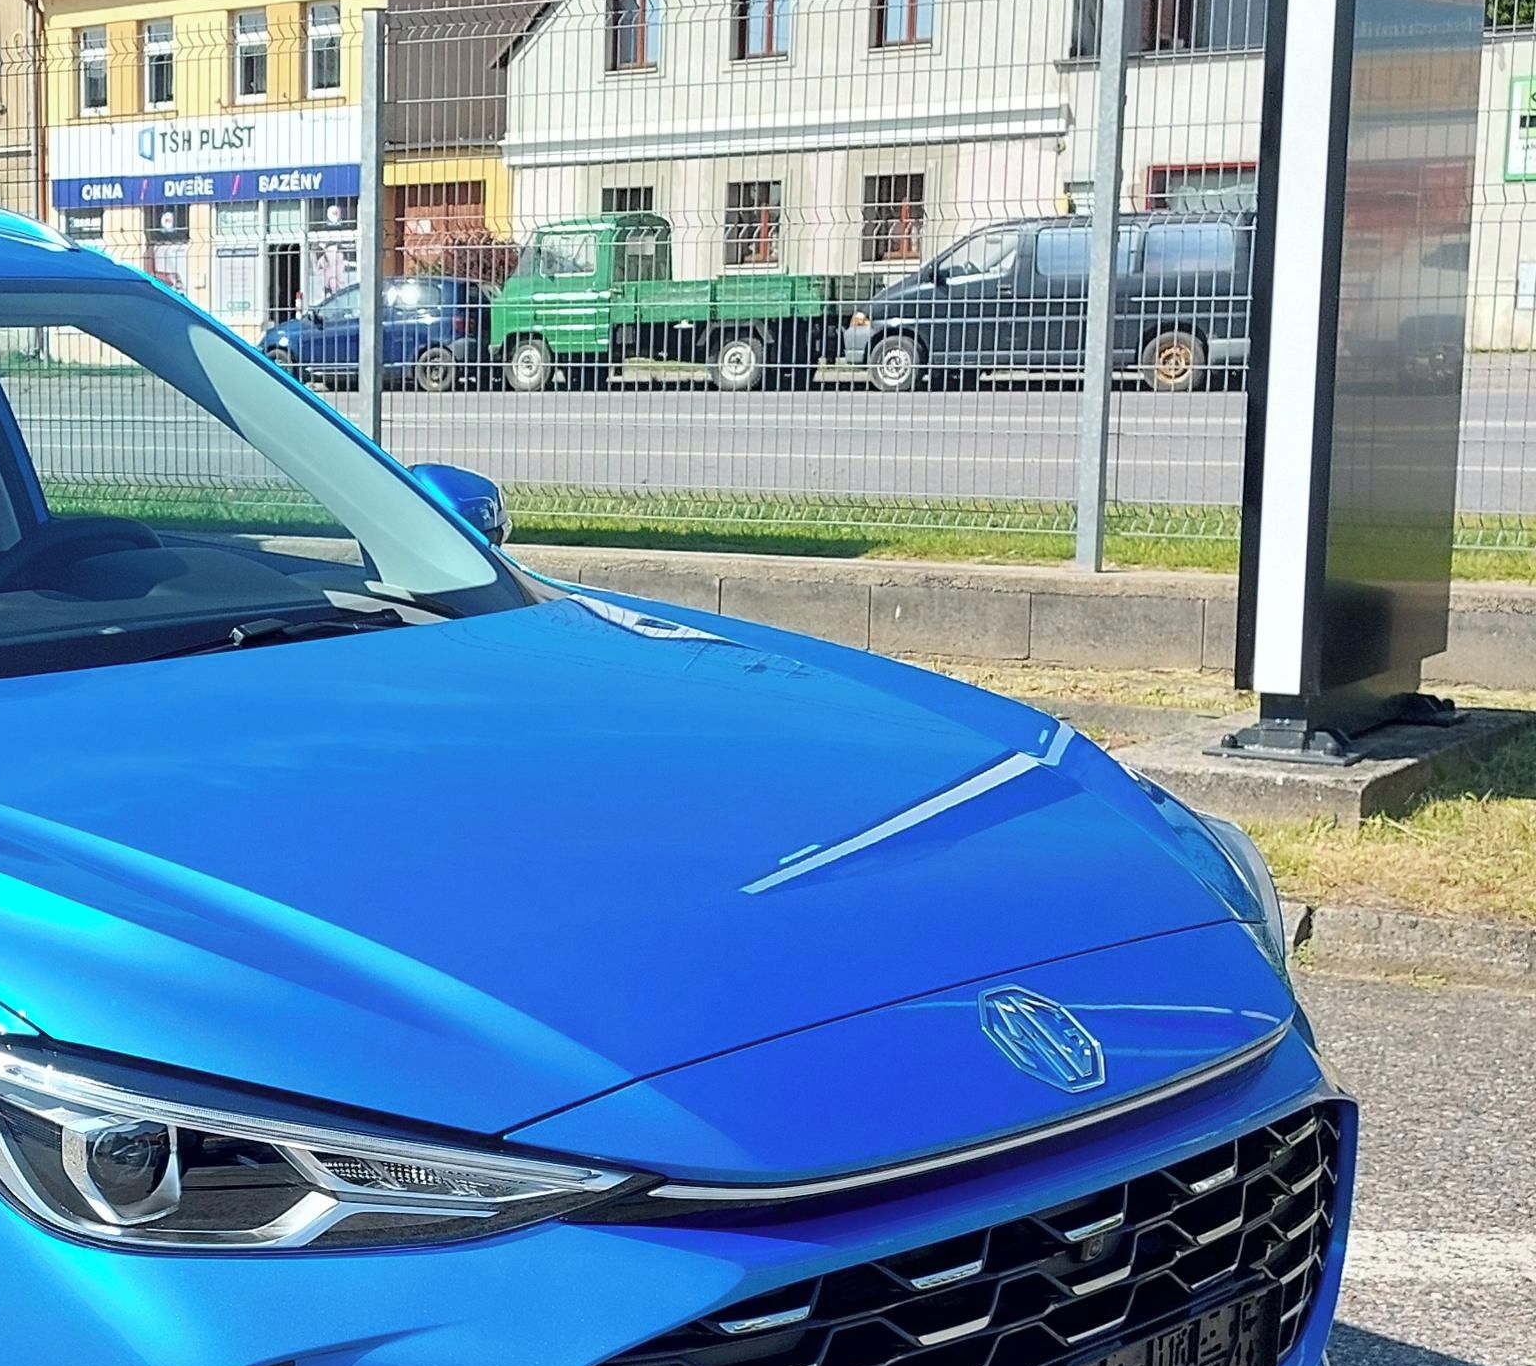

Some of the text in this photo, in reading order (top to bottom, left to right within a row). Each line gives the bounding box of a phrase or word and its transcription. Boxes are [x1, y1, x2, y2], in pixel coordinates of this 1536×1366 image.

[158, 125, 256, 154] TSH PLAST
[81, 170, 323, 201] OKNA DVEŘE BAZÉNY
[987, 992, 1098, 1087] MG
